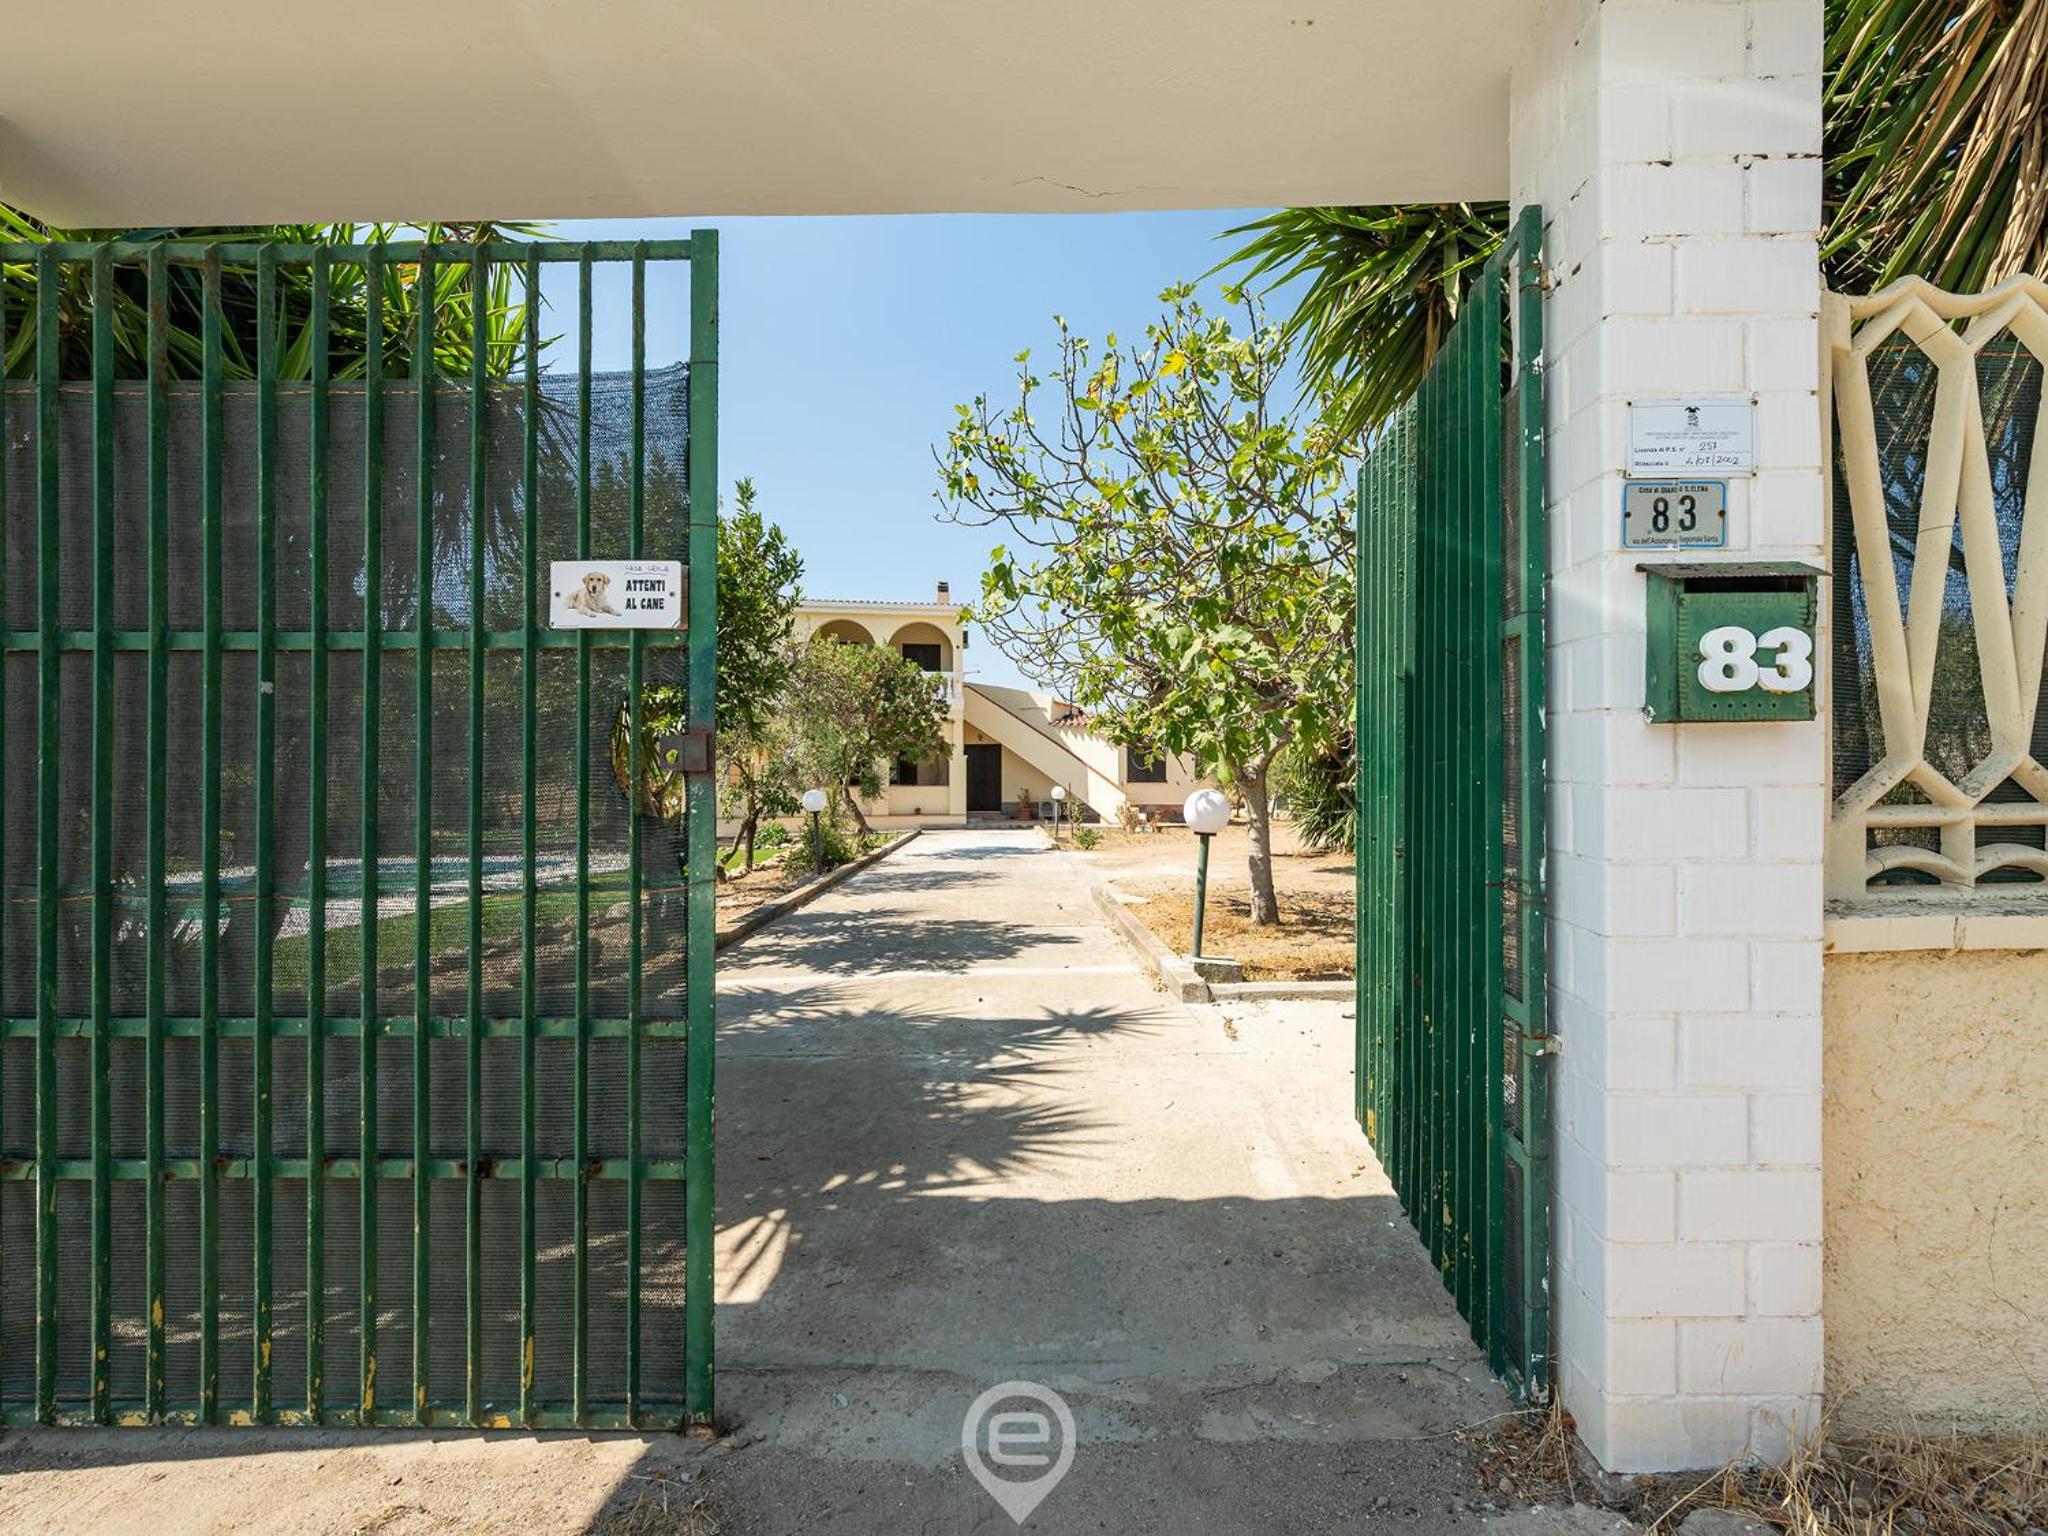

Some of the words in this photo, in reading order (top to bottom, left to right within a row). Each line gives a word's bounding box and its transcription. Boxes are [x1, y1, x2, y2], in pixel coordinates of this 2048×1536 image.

[1652, 495, 1696, 533] 83
[625, 579, 666, 592] ATTENTI
[625, 597, 637, 610] AL
[640, 597, 665, 610] CANE
[1697, 626, 1813, 693] 83
